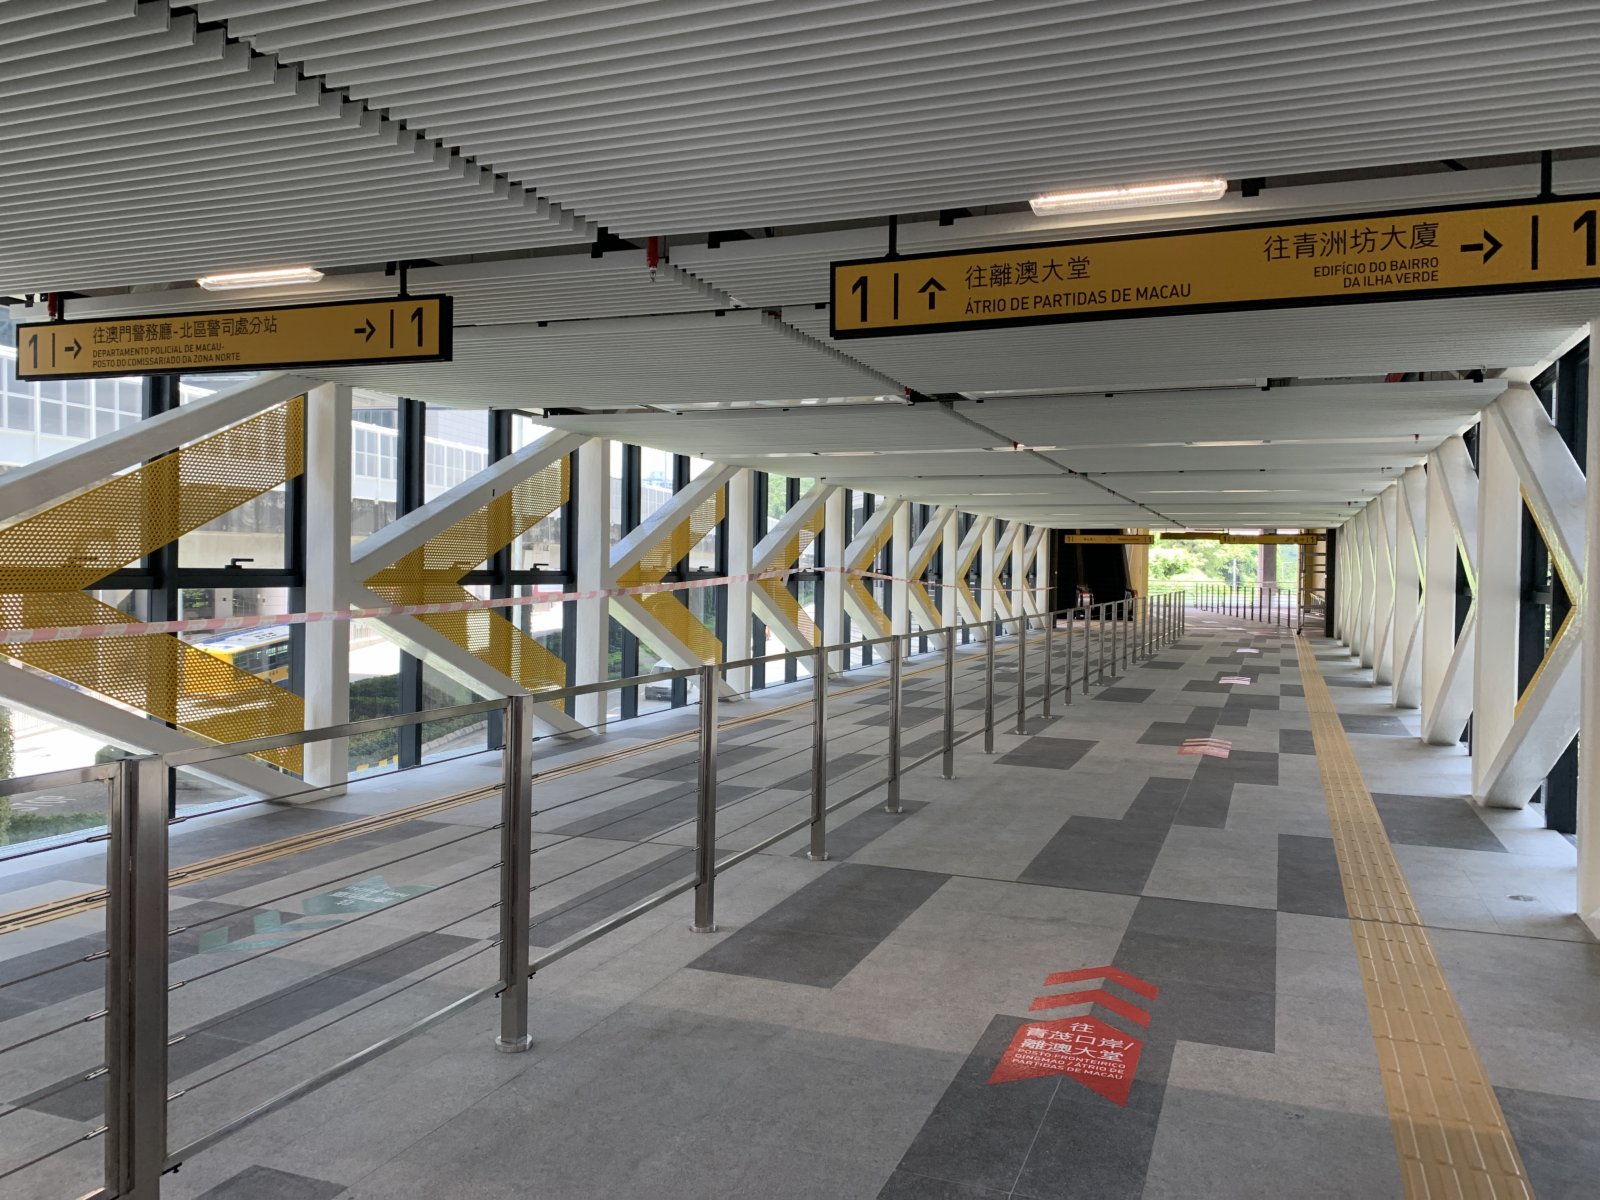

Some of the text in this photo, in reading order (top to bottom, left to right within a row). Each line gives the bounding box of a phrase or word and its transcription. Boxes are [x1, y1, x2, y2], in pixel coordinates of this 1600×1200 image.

[1263, 222, 1439, 262] 往青洲坊大廈
[1573, 210, 1596, 266] 1
[965, 256, 1091, 290] 往離澳大堂
[1314, 257, 1439, 277] EDIFÍCIO DO BAIRRO
[1343, 271, 1439, 288] DA ILHA VERDE
[851, 275, 868, 322] 1
[965, 283, 1192, 314] ÁTRIO DE PARTIDAS DE MACAU
[410, 306, 424, 347] 1
[28, 334, 38, 369] 1
[92, 347, 150, 359] DEPARTAMENTO
[150, 345, 183, 355] POLICIAL
[184, 344, 194, 353] DE
[92, 352, 241, 368] POSTO DO COMISSARIADO DA ZONA NORTE
[1070, 1022, 1095, 1034] 往
[1017, 1048, 1052, 1058] POSTO
[1020, 1038, 1124, 1062] 離澳大堂
[1012, 1058, 1123, 1080] PARTIDAS DE MACAU
[1109, 1067, 1125, 1075] DE
